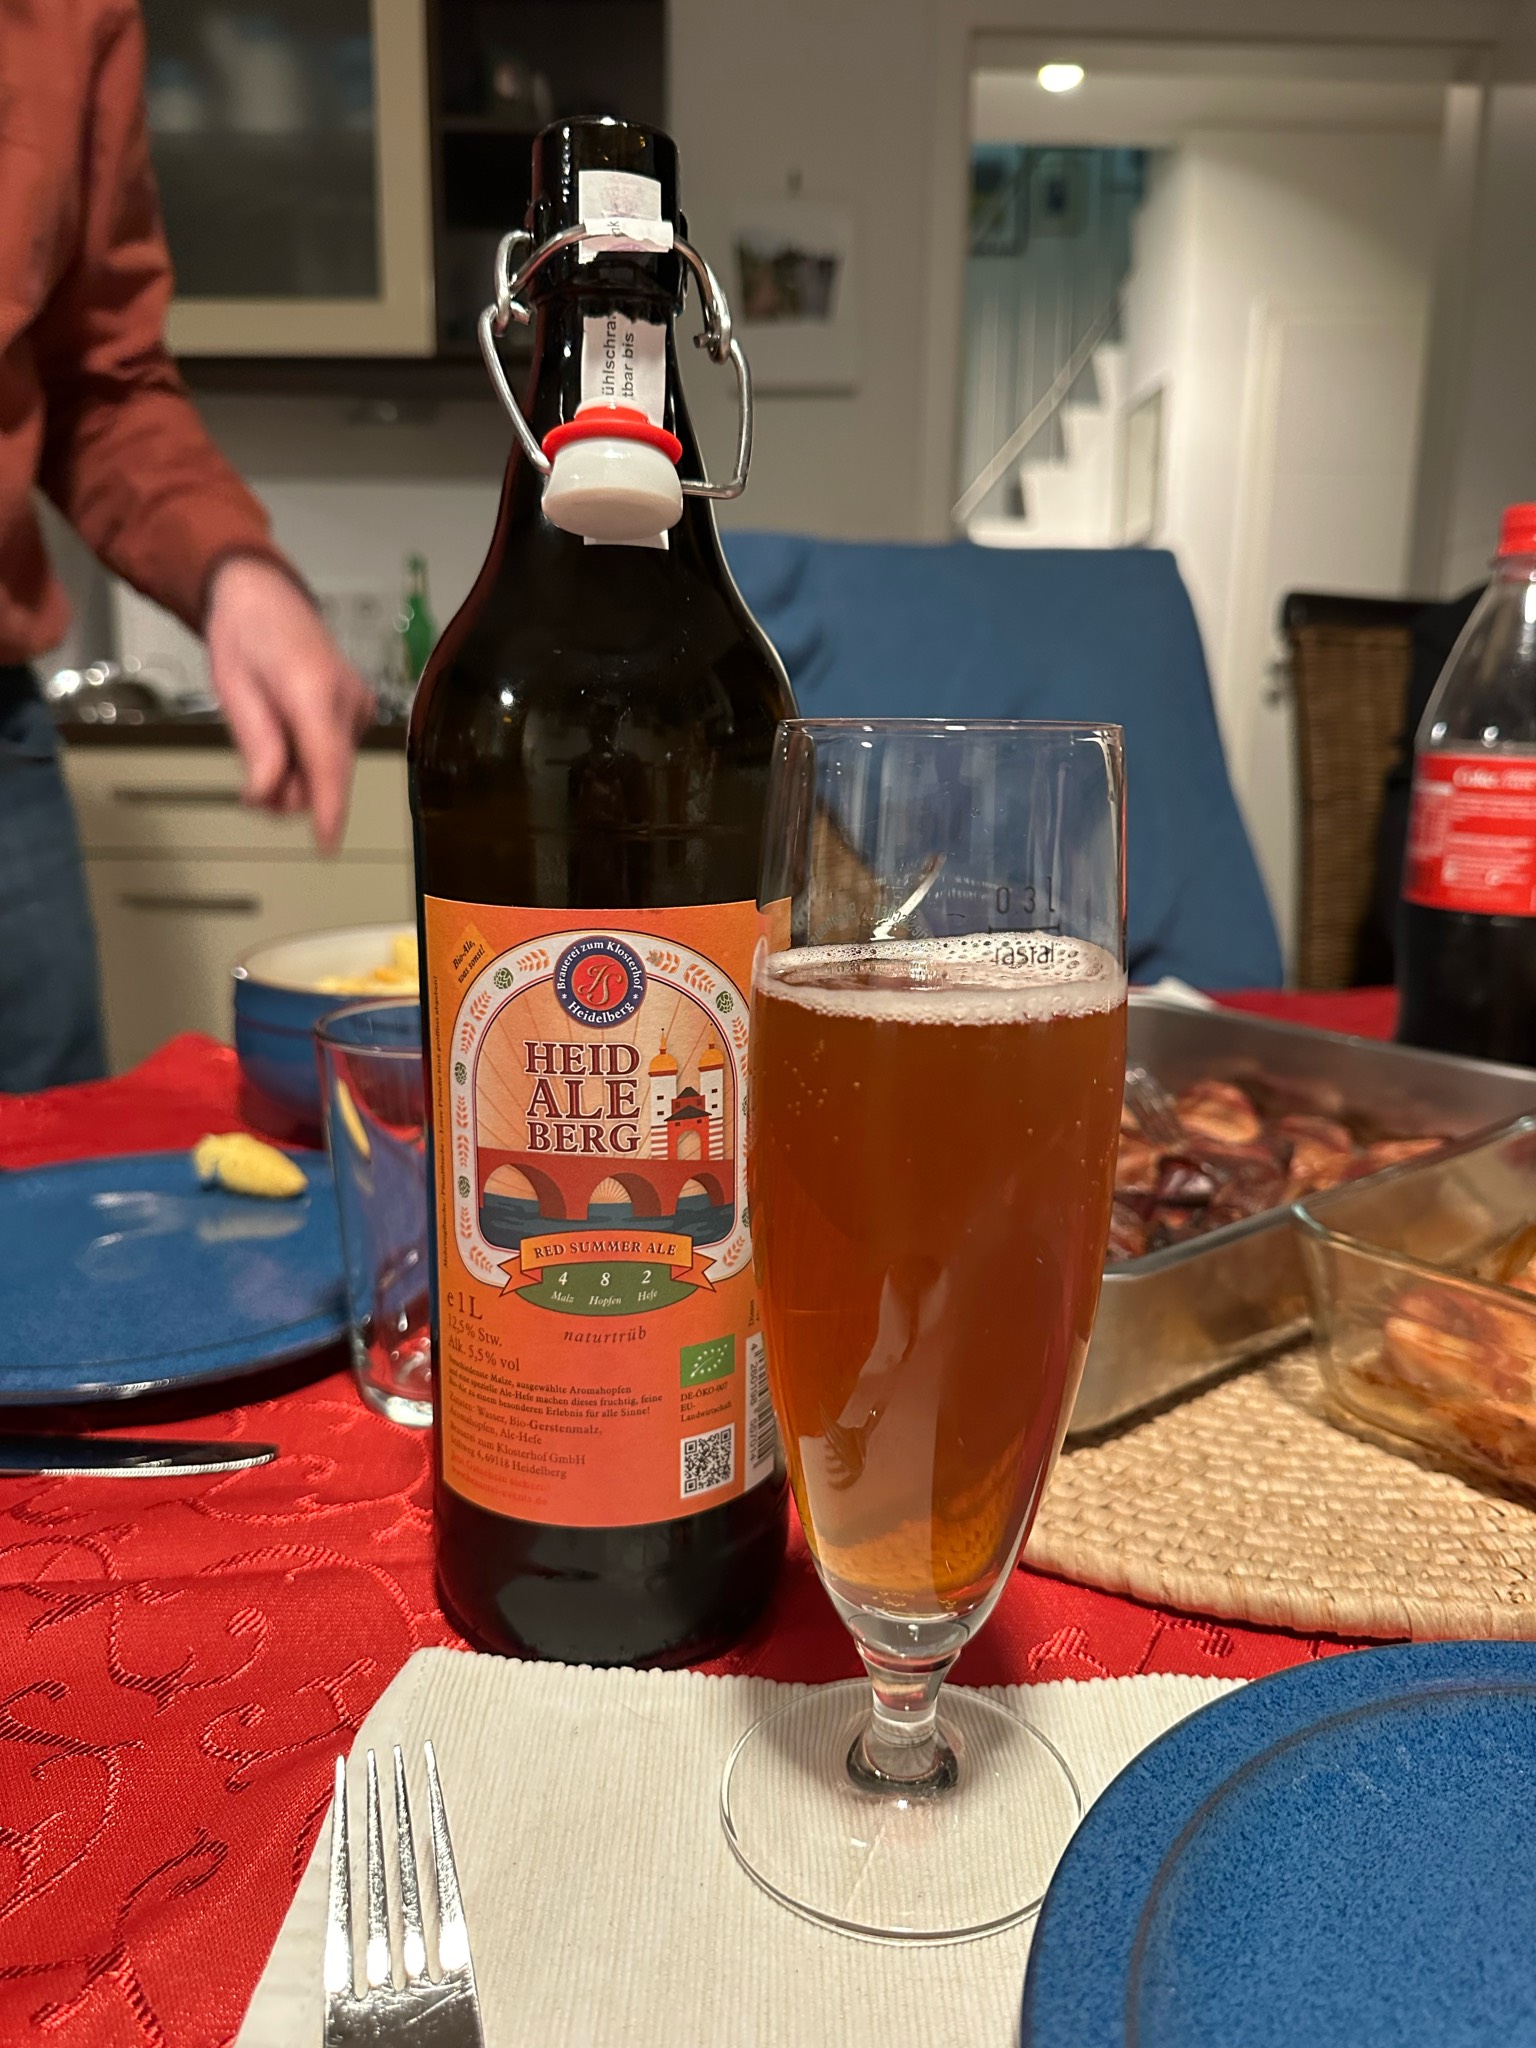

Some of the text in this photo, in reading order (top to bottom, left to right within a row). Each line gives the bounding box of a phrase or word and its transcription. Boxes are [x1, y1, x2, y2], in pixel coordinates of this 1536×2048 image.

[602, 315, 617, 396] ühlschra
[621, 332, 634, 399] tbar bis
[453, 940, 476, 970] Bio-Ale,
[458, 944, 485, 983] was sonst!
[557, 941, 643, 991] Brauerei zum Klosterhof
[567, 1001, 635, 1024] Heidelberg
[523, 1041, 641, 1076] HEID
[526, 1077, 641, 1121] ALE
[526, 1120, 642, 1153] BERG
[534, 1241, 677, 1259] RED SUMMER ALE
[558, 1270, 652, 1287] 4 8 2
[551, 1289, 658, 1308] Malz Hopfen Hefe
[448, 1313, 502, 1347] 12,5% Stw.
[564, 1326, 647, 1344] naturtrüb
[448, 1334, 520, 1372] Alk. 5,5% vol
[490, 1373, 515, 1388] Malze,
[516, 1380, 567, 1394] ausgewählte
[569, 1385, 632, 1396] Aromahopfen
[500, 1387, 534, 1402] Ale-Hefe
[536, 1396, 569, 1405] machen
[571, 1397, 597, 1406] dieses
[600, 1397, 639, 1407] fruchtig,
[641, 1394, 662, 1404] feine
[680, 1381, 729, 1402] DE-ÖKO-007
[477, 1405, 508, 1424] Wasser,
[509, 1415, 603, 1435] Bio-Gerstenmalz,
[499, 1400, 544, 1415] besonderen
[546, 1406, 583, 1417] Erlebnis
[586, 1408, 599, 1418] für
[602, 1409, 618, 1417] alle
[621, 1406, 650, 1416] Sinne!
[680, 1403, 696, 1413] EU-
[680, 1401, 732, 1422] Landwirtschaft
[500, 1428, 542, 1445] Ale-Hefe
[477, 1437, 495, 1450] zum
[497, 1441, 548, 1462] Klosterhof
[549, 1453, 586, 1466] GmbH
[485, 1454, 510, 1469] 69118
[512, 1461, 567, 1480] Heidelberg
